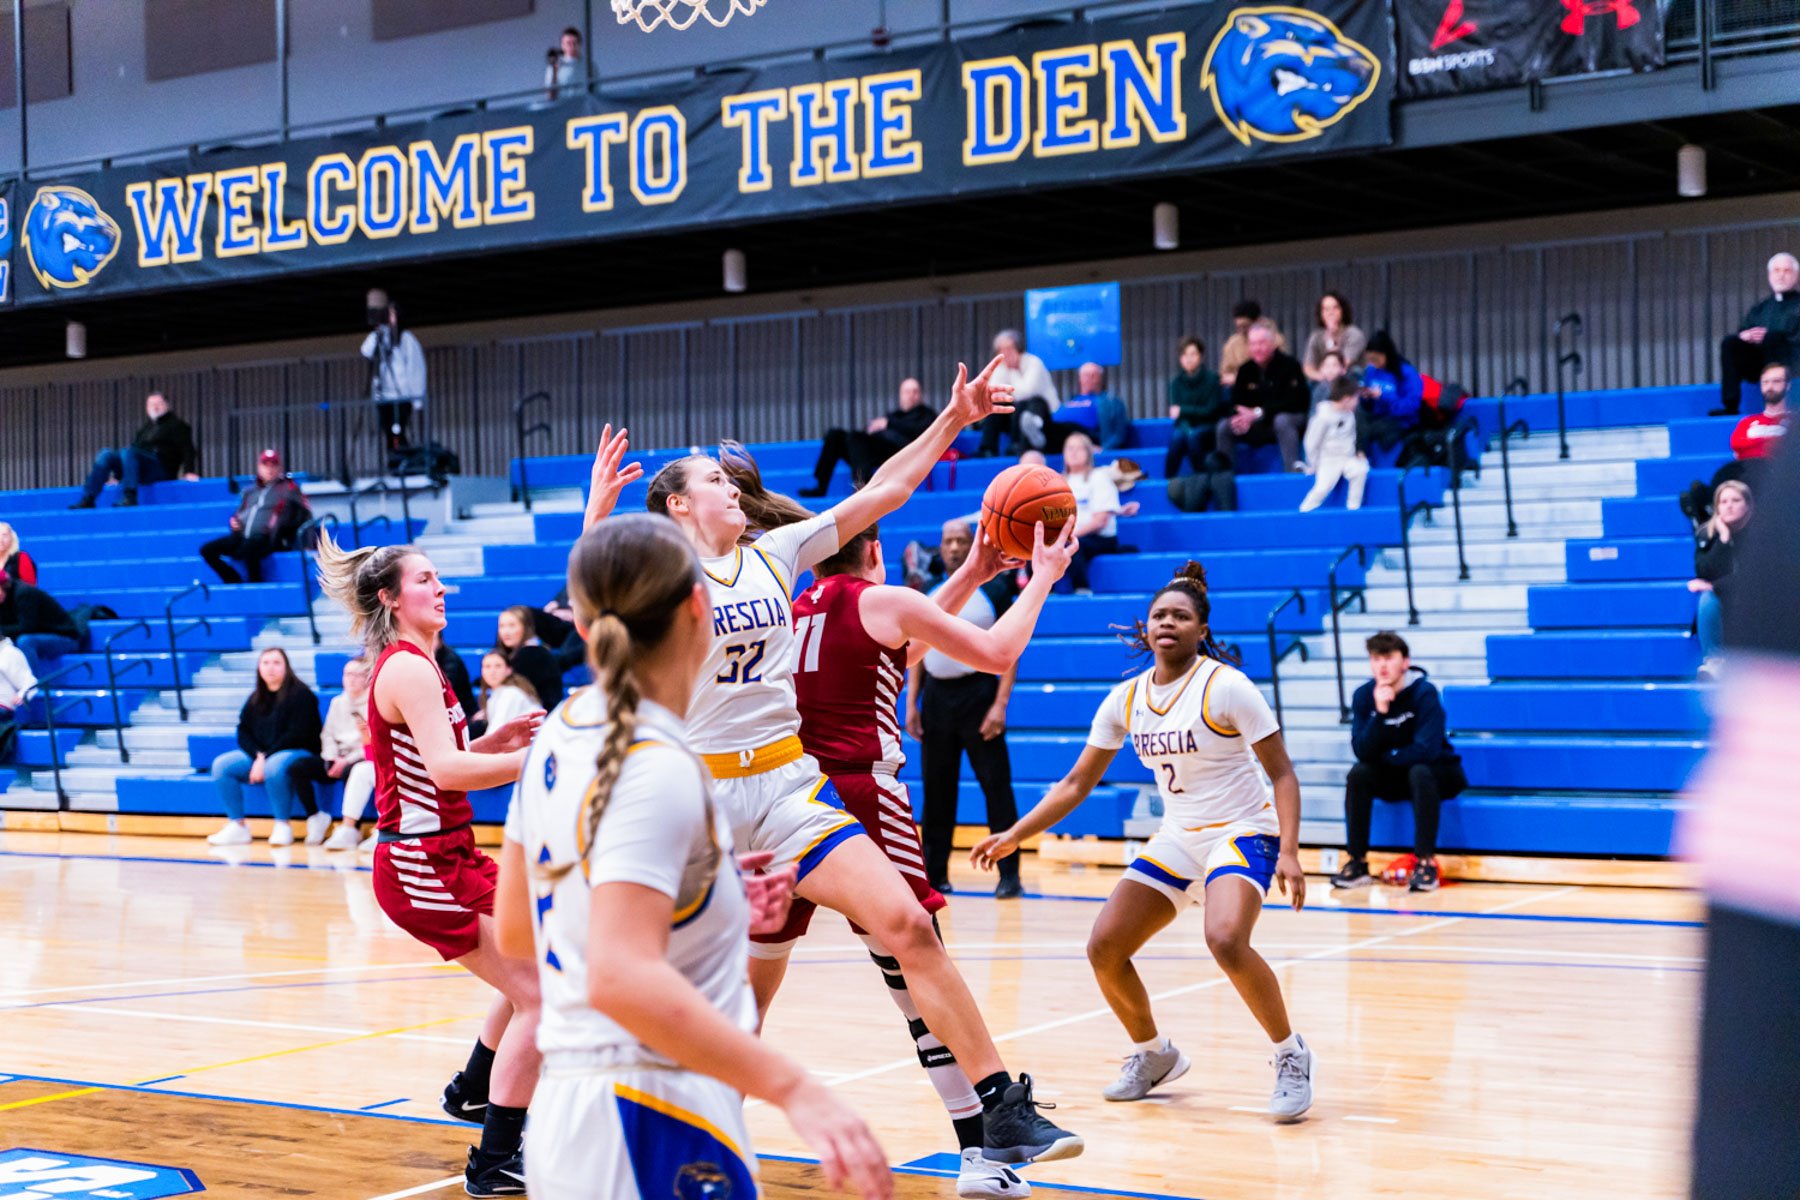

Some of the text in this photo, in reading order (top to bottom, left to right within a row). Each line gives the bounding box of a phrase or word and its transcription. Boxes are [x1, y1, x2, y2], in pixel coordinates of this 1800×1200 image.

[1443, 48, 1496, 70] SPORTS
[126, 32, 1187, 267] WELCOME TO THE DEN
[713, 597, 787, 637] RESCIA
[716, 639, 767, 685] 32
[791, 612, 827, 674] 11
[1133, 729, 1199, 758] BRESCIA
[1161, 762, 1185, 795] 2
